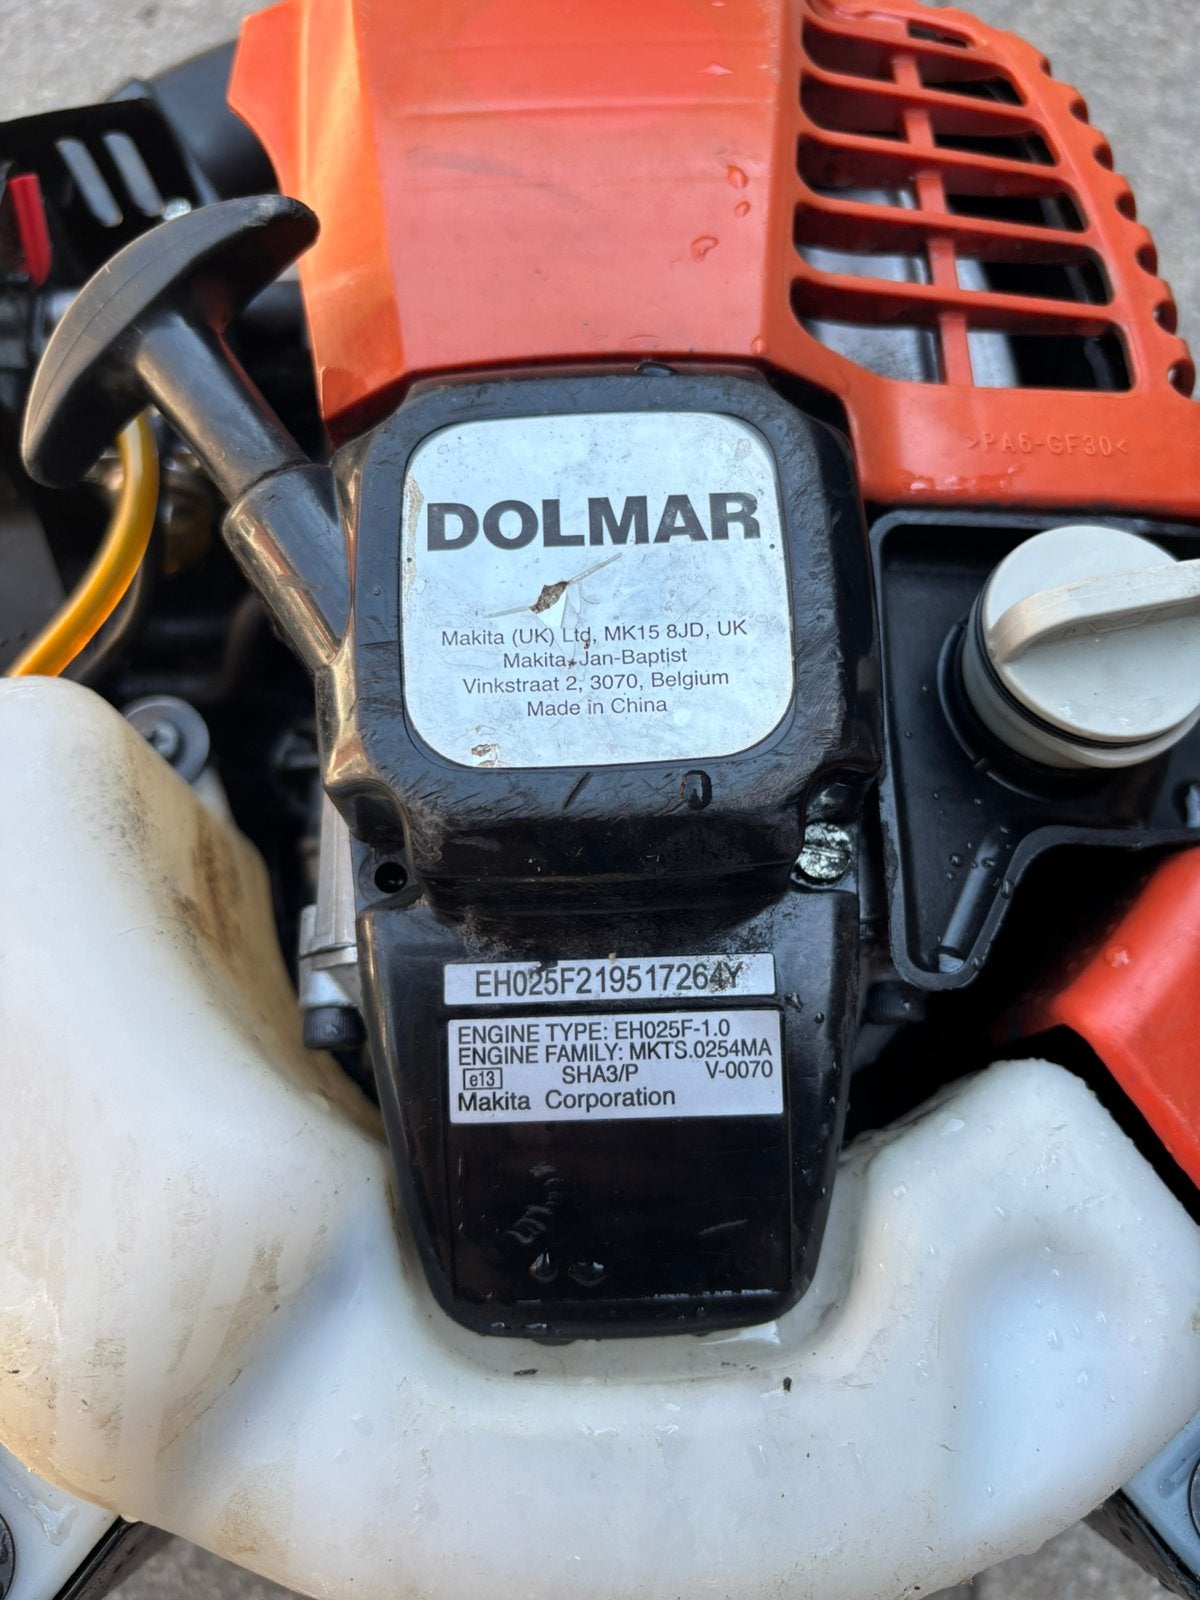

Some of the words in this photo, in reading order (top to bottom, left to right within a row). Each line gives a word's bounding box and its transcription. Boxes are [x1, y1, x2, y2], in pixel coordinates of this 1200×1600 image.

[427, 492, 761, 551] DOLMAR
[441, 630, 504, 646] Makita
[512, 628, 555, 646] (UK)
[563, 627, 597, 646] Ltd,
[604, 624, 660, 641] MK15
[666, 622, 710, 639] 8JD,
[718, 620, 748, 636] UK
[578, 648, 688, 668] Jan-Baptist
[463, 677, 560, 694] Vinkstraat
[566, 676, 583, 693] 2,
[591, 674, 643, 691] 3070,
[651, 671, 729, 690] Belgium
[527, 701, 580, 717] Made
[588, 700, 603, 714] in
[611, 698, 667, 714] China
[475, 962, 744, 997] EH025F219517264Y
[458, 1024, 540, 1045] ENGINE
[546, 1023, 608, 1042] TYPE:
[614, 1019, 730, 1040] EH025F-1.0
[458, 1045, 539, 1065] ENGINE
[545, 1043, 623, 1063] FAMILY:
[629, 1038, 772, 1060] MKTS.0254MA
[469, 1071, 495, 1088] e13
[562, 1064, 639, 1084] SHA3/P
[705, 1060, 773, 1079] V-0070
[458, 1092, 531, 1112] Makita
[545, 1088, 676, 1112] Corporation
